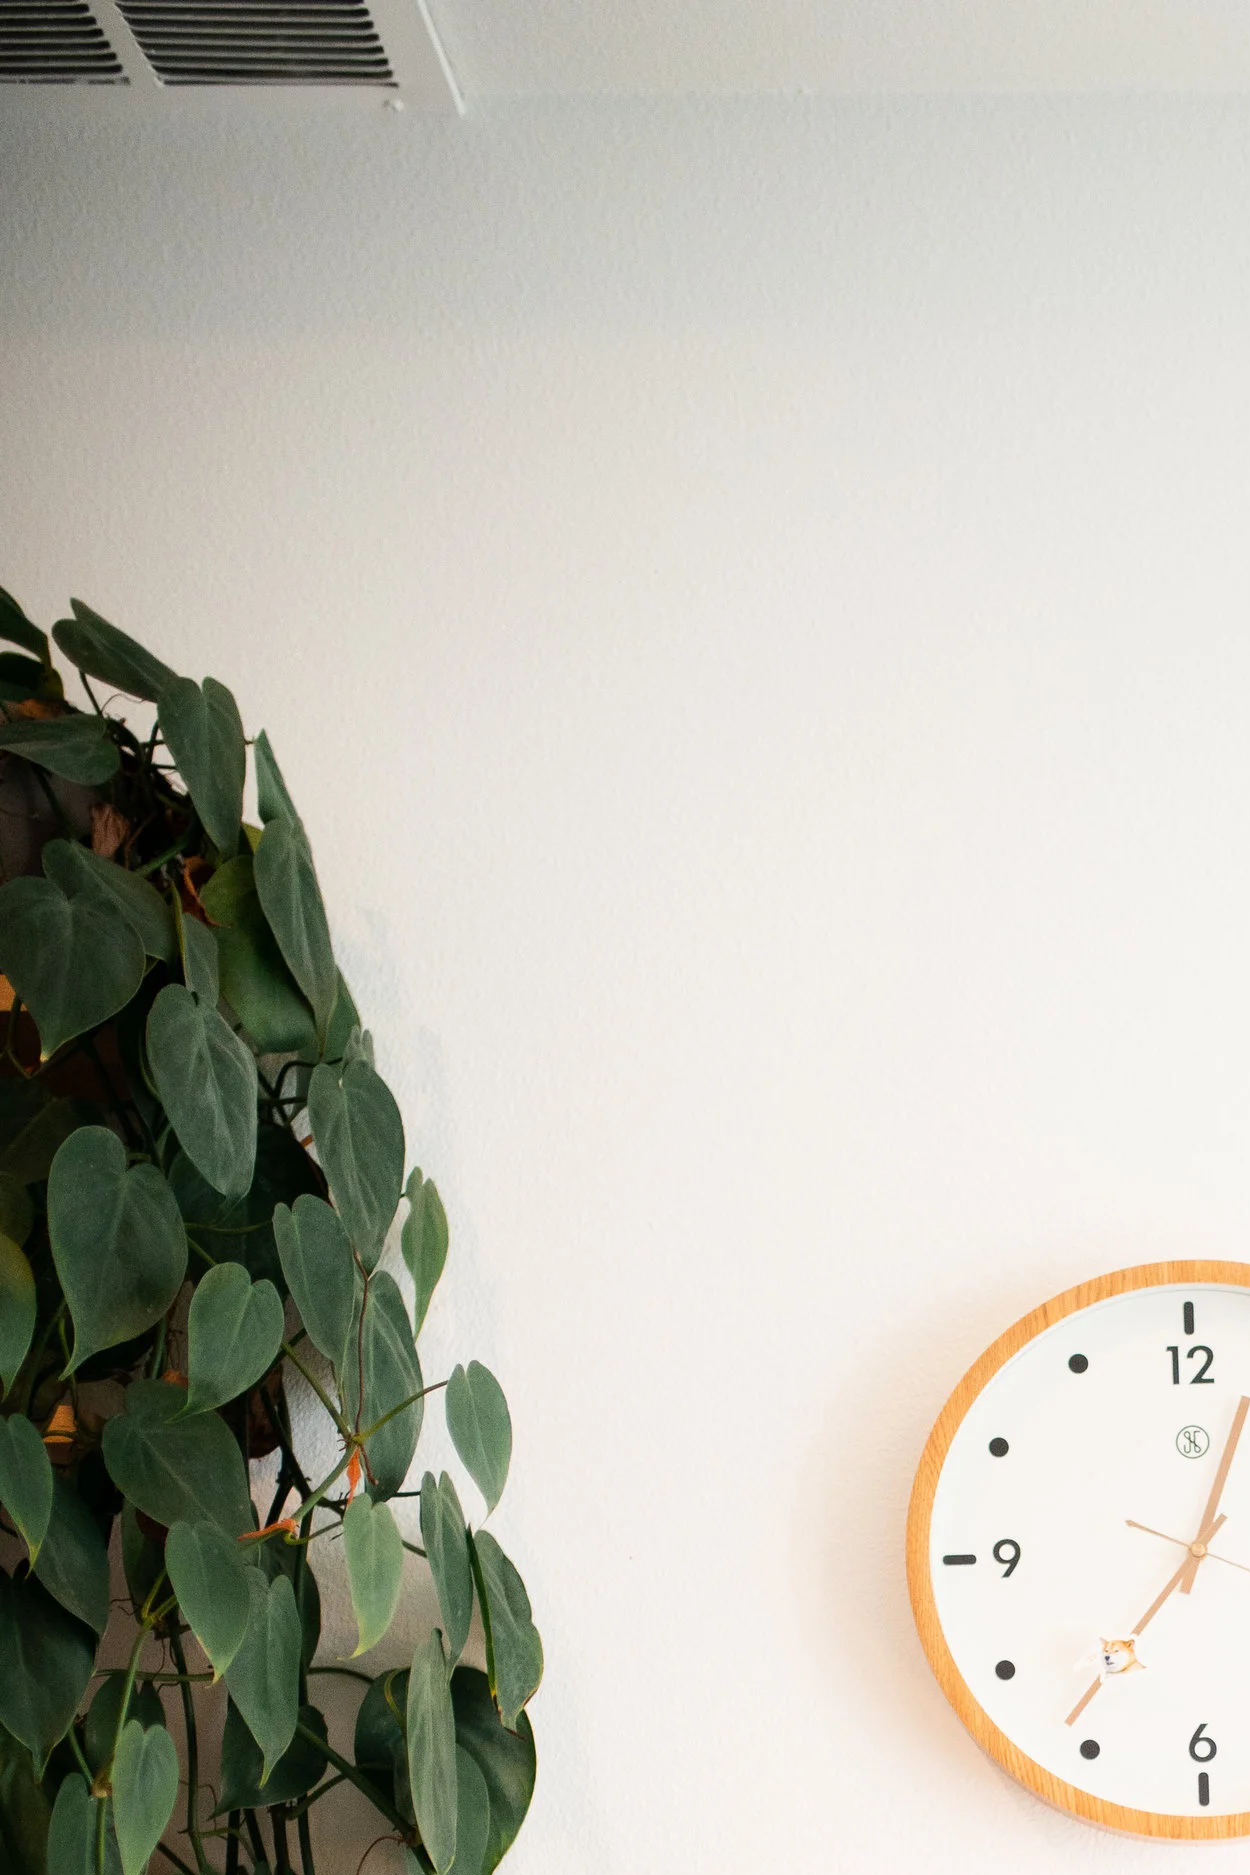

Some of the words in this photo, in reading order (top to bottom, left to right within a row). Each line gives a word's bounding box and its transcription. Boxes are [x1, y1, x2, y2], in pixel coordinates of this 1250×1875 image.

[1165, 1345, 1215, 1385] 12
[992, 1538, 1021, 1578] 9
[1188, 1723, 1217, 1763] 6
